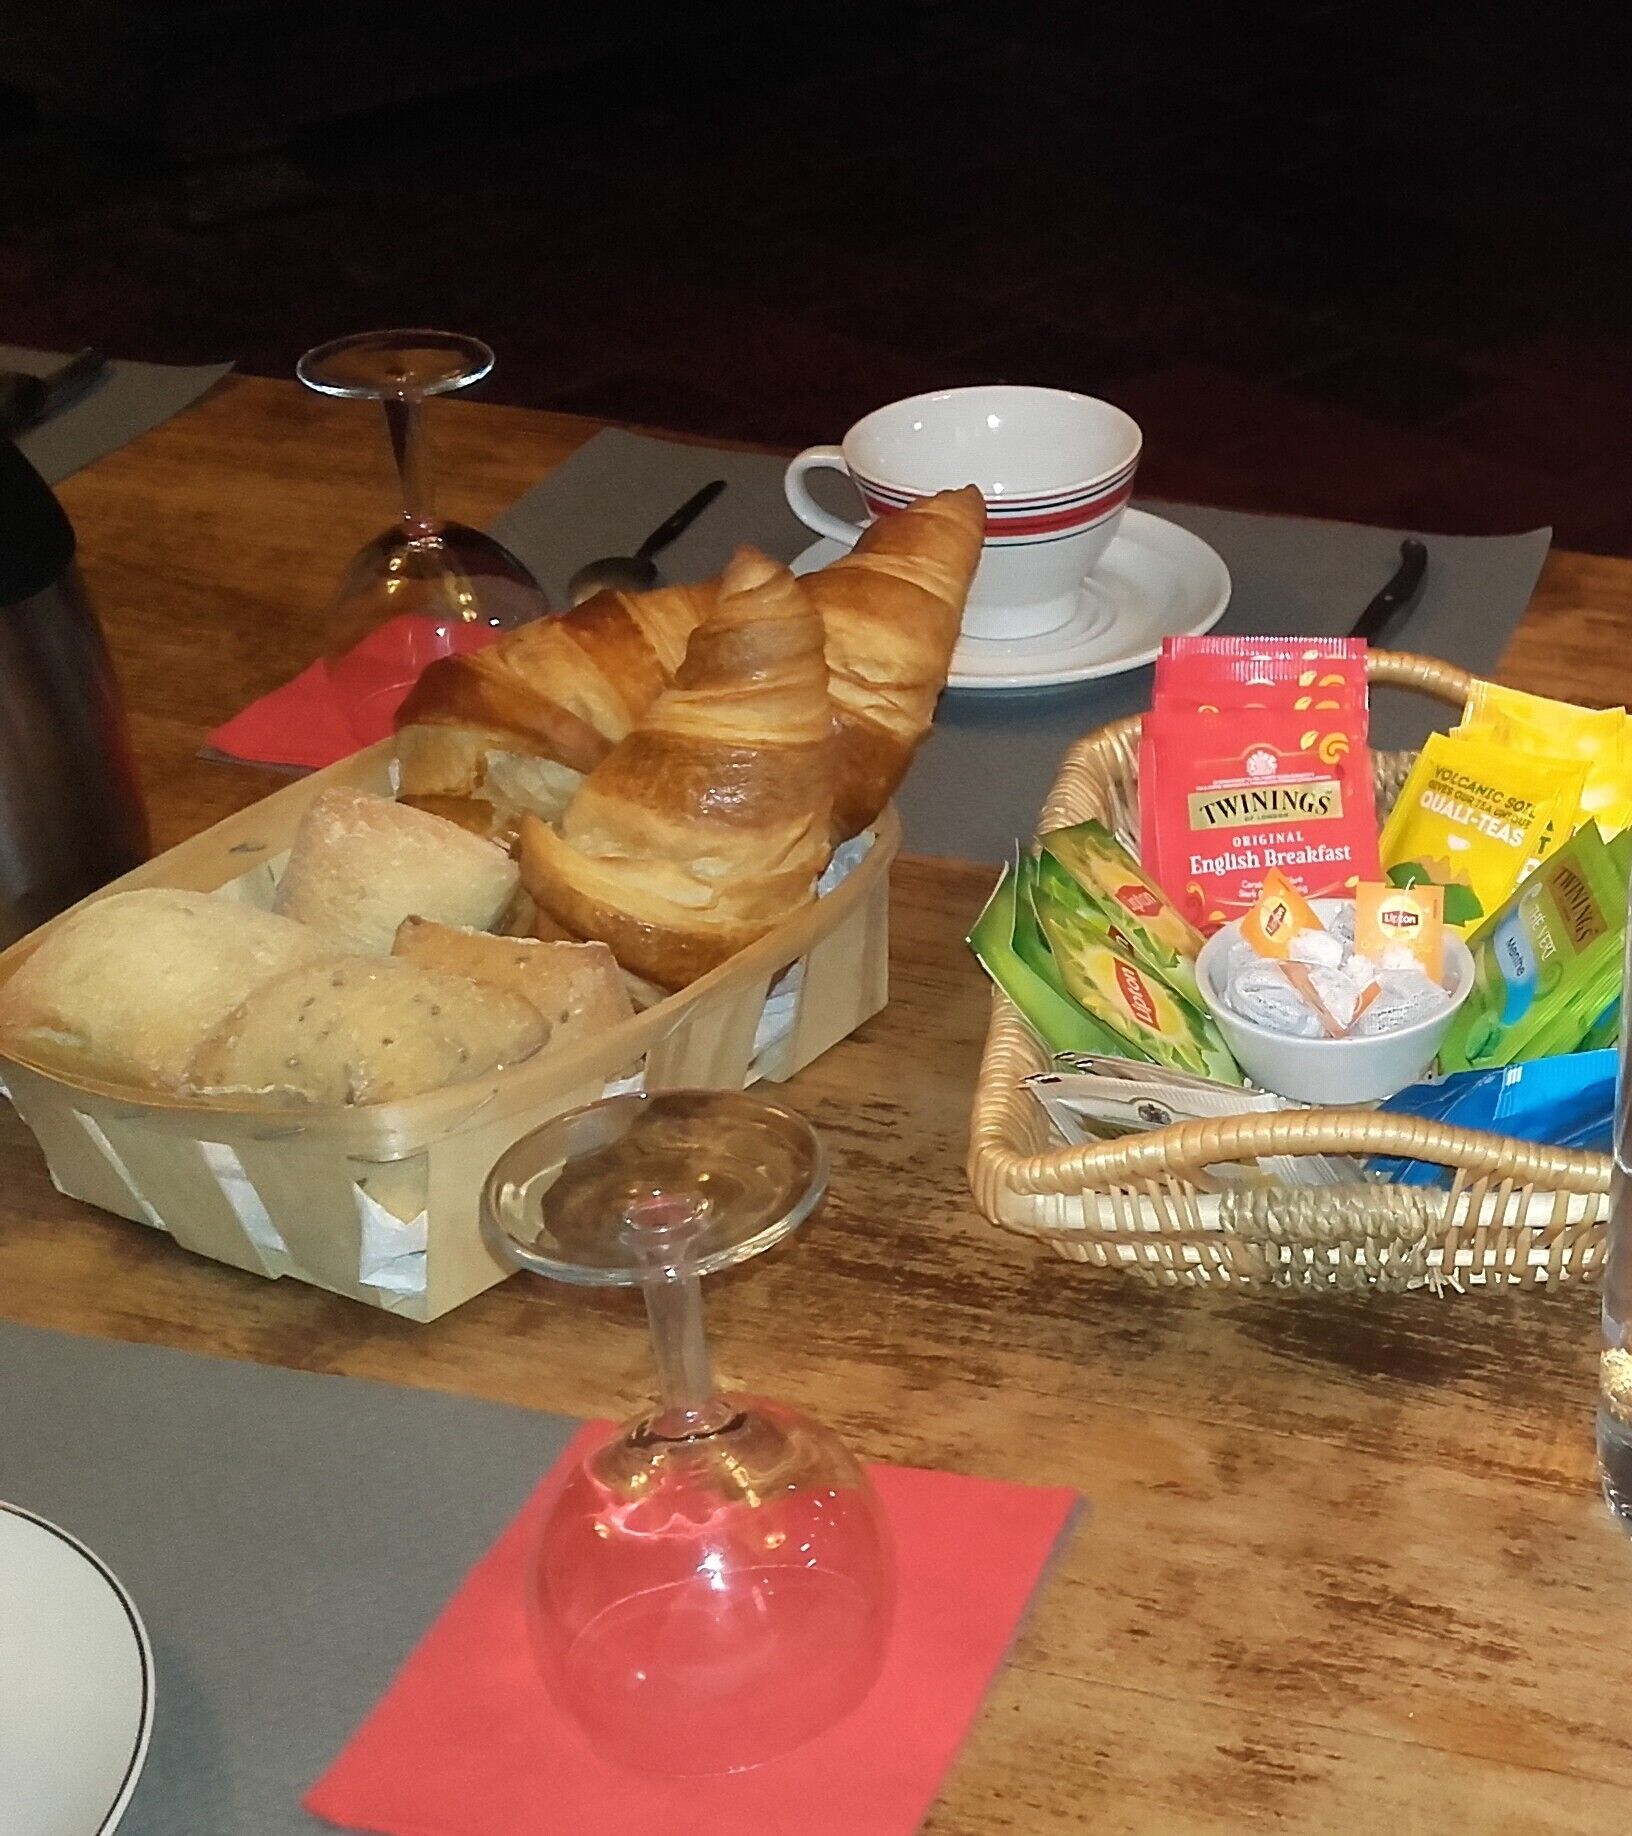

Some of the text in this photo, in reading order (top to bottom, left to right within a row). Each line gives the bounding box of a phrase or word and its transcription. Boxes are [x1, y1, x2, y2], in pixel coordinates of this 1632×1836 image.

[1199, 790, 1331, 824] TWININGS
[1435, 765, 1536, 819] VOLCANIC SOIL
[1232, 831, 1304, 847] ORIGINAL
[1420, 790, 1525, 848] QUALI-TEAS
[1189, 845, 1352, 876] English Breakfast
[1552, 868, 1592, 943] TWININGS
[1538, 925, 1557, 961] VERT
[1121, 966, 1154, 1024] Lipton
